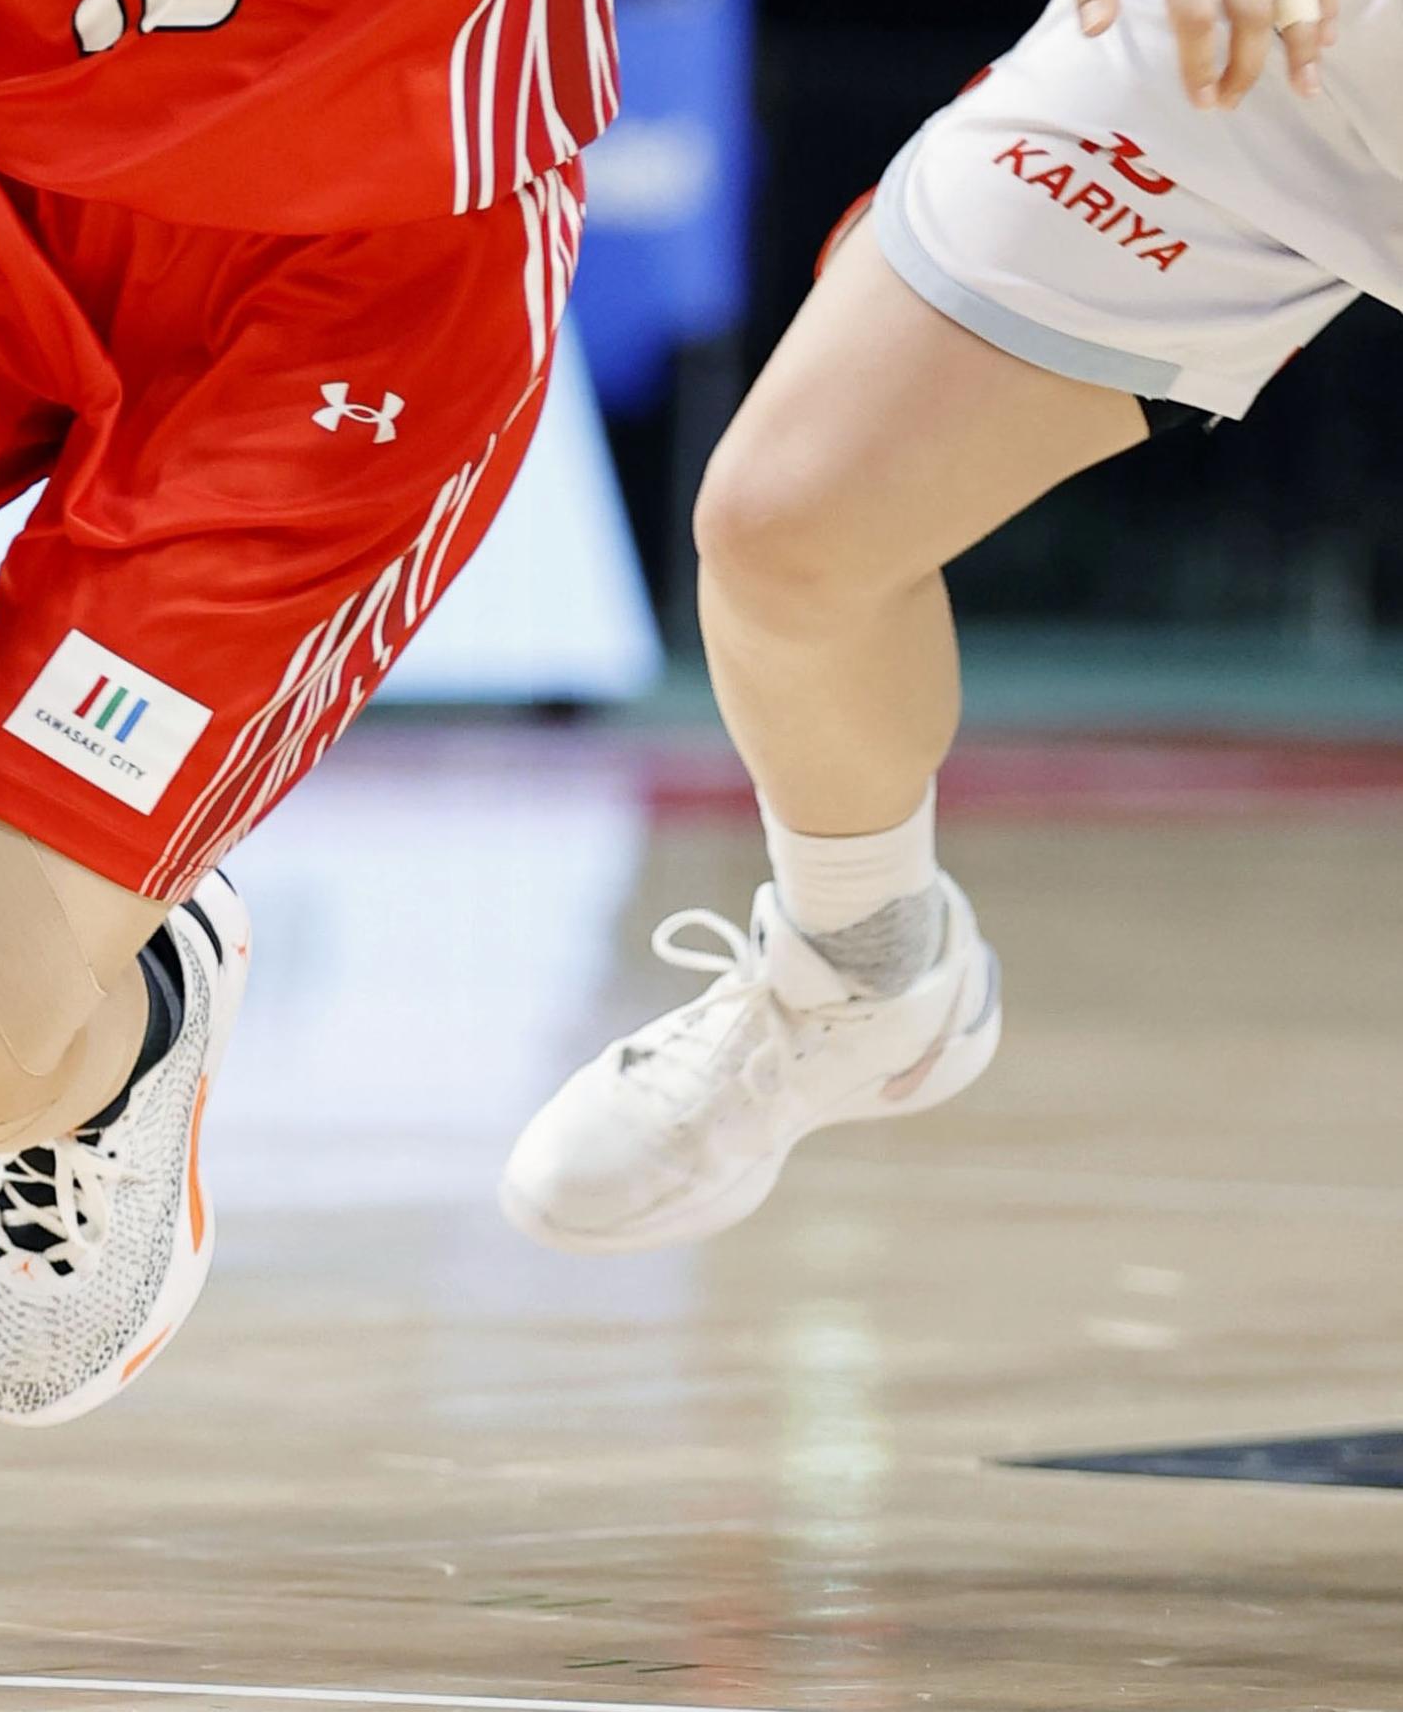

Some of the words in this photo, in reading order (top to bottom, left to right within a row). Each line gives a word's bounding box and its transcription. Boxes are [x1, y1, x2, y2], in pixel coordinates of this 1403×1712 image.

[994, 139, 1191, 273] KARIYA
[35, 708, 105, 757] KAWASAKI
[109, 754, 146, 780] CITY
